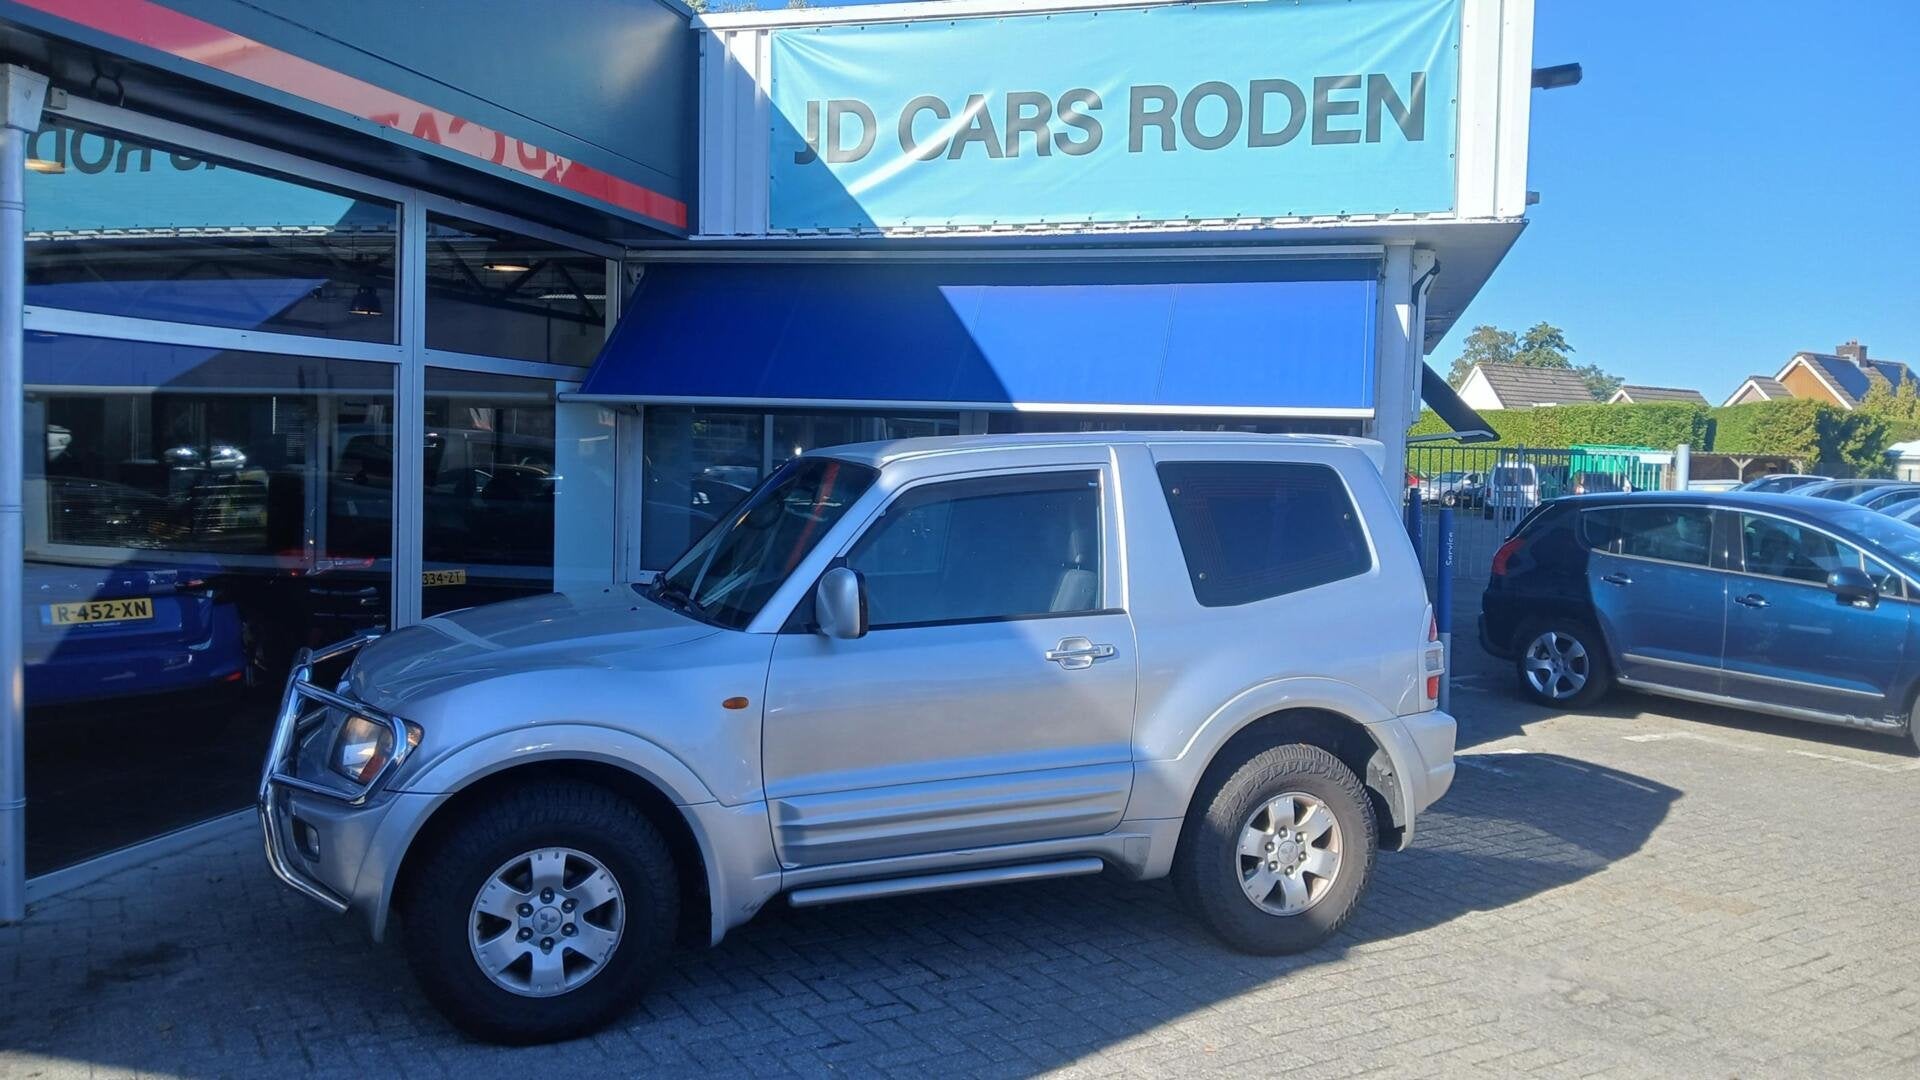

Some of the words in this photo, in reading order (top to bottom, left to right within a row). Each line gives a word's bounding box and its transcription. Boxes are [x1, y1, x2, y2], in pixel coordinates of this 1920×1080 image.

[794, 99, 877, 165] JD
[898, 88, 1104, 161] CARS
[1128, 71, 1427, 154] RODEN
[1445, 531, 1454, 566] Service
[57, 600, 148, 623] R-452-XN
